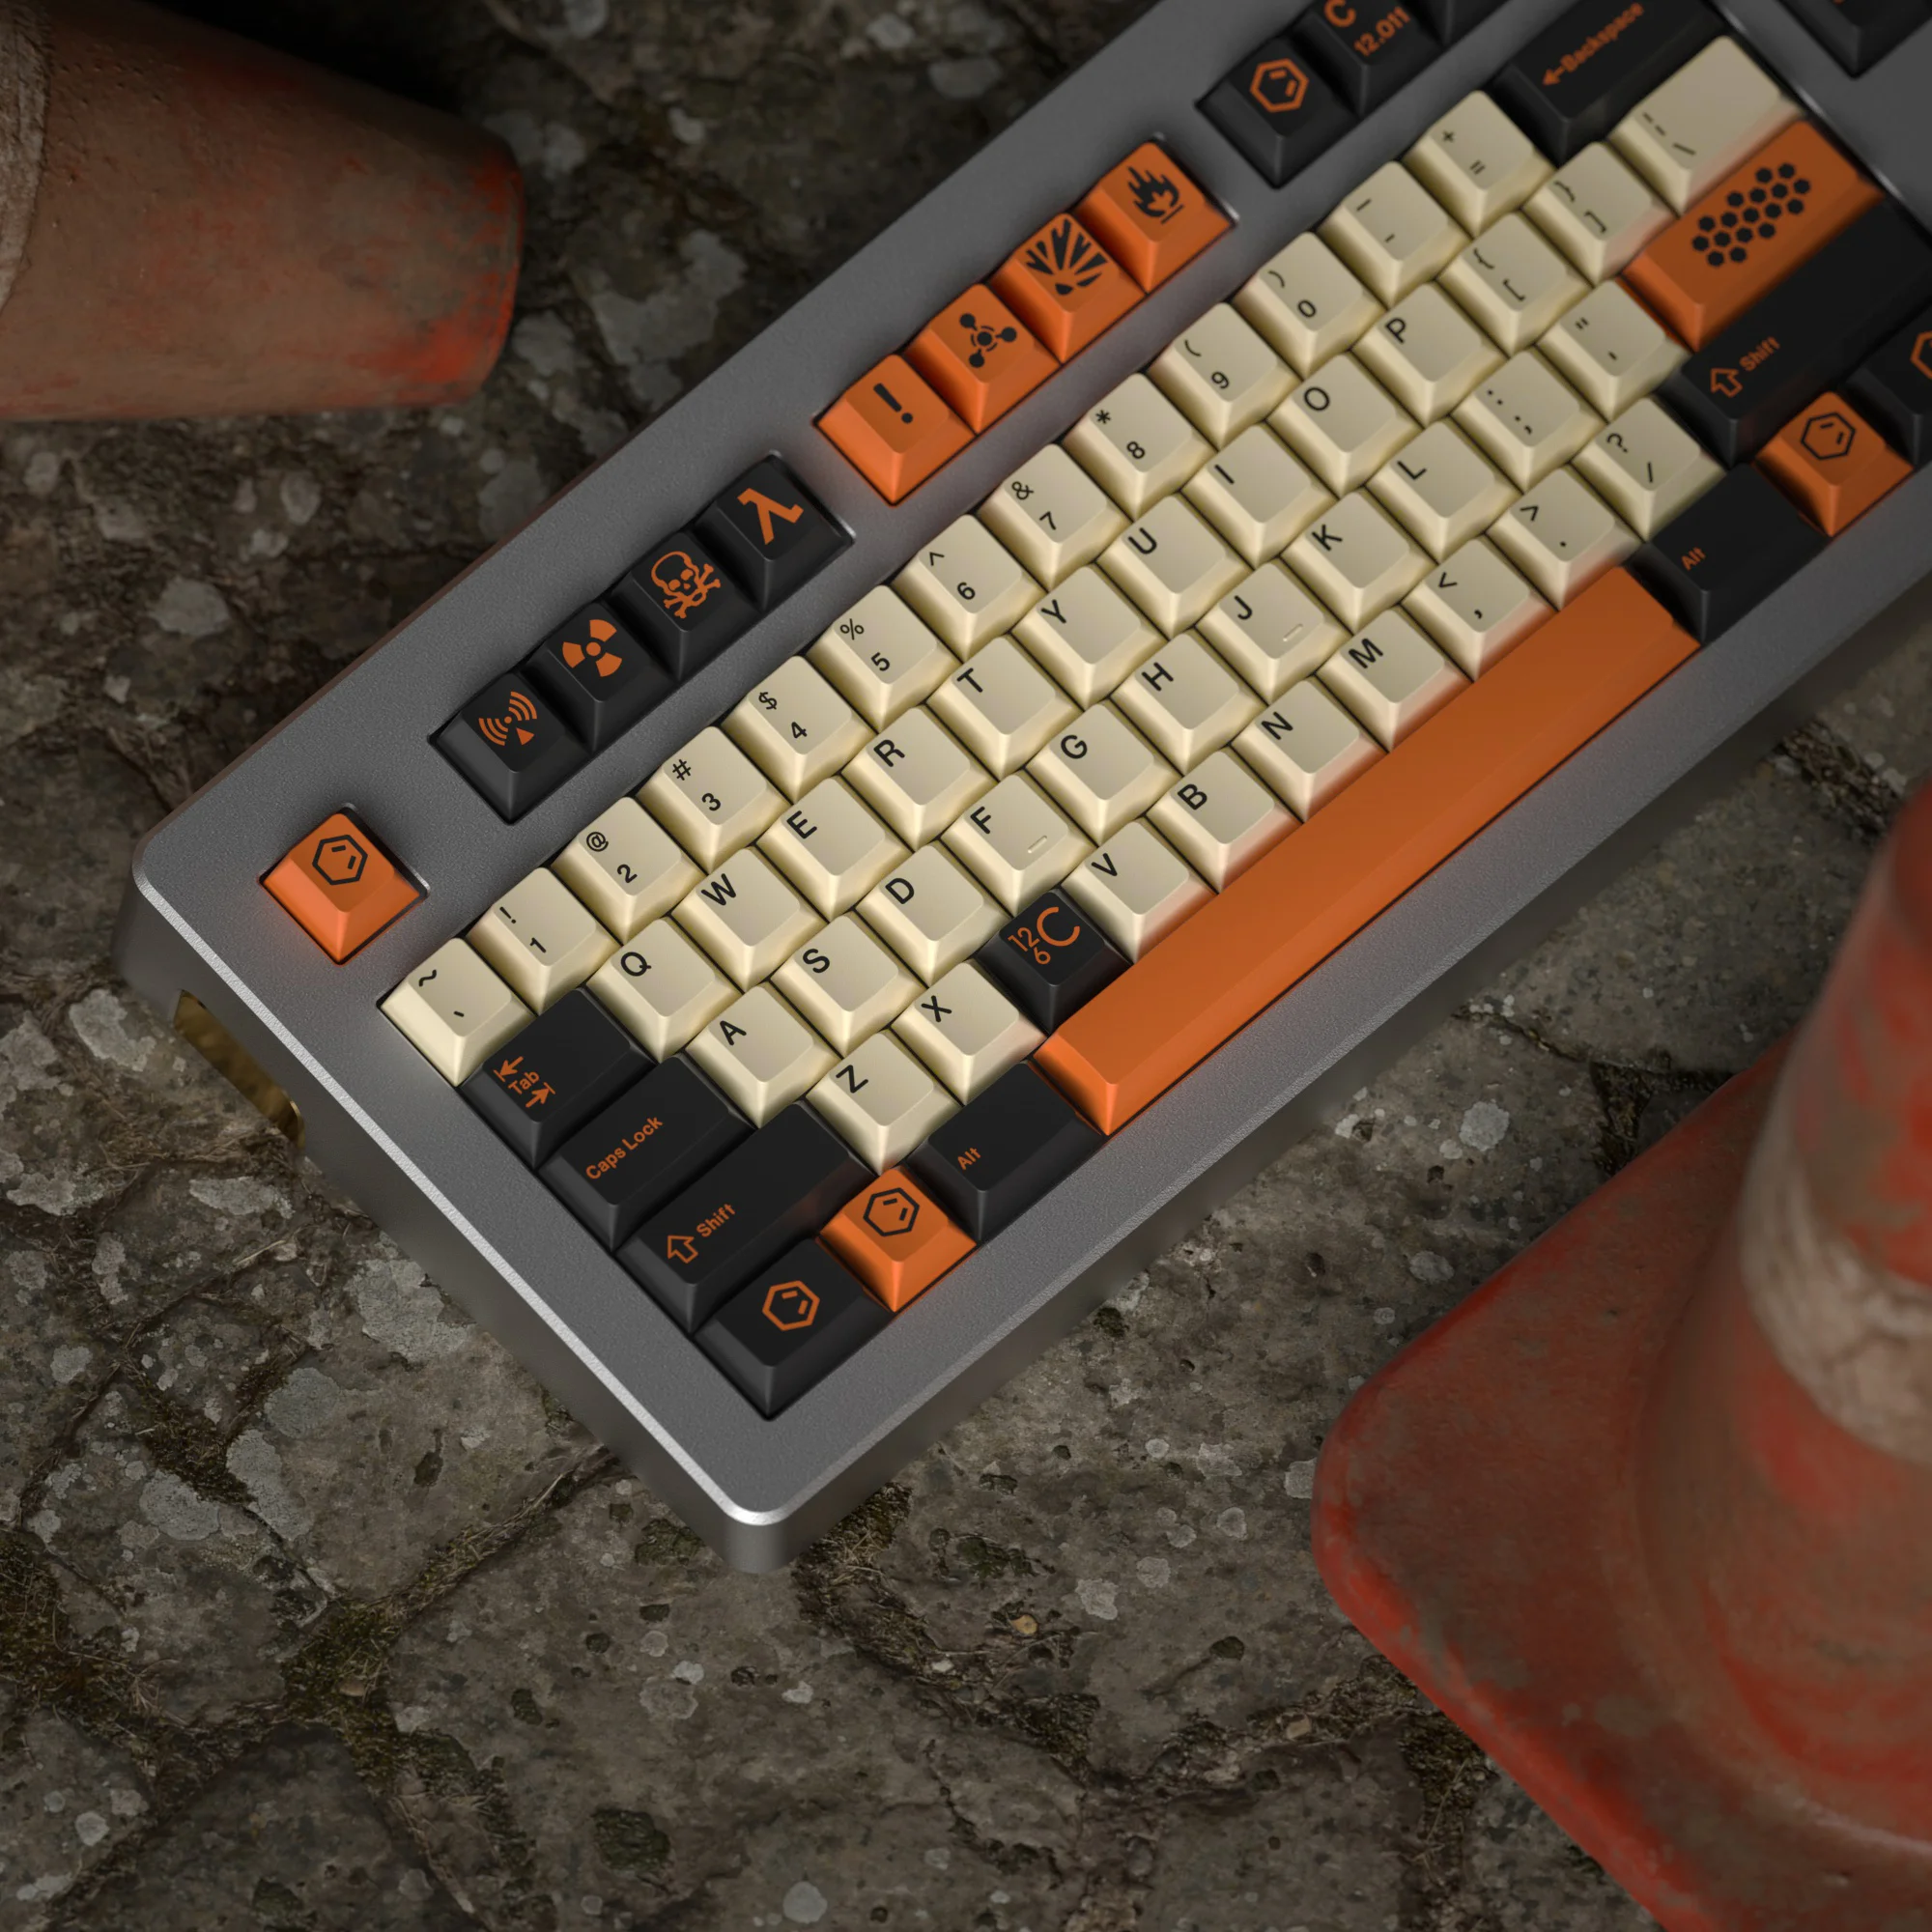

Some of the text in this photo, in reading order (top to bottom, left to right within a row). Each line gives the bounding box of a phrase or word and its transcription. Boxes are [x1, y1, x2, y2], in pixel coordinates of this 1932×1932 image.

[1353, 6, 1410, 56] 12.011
[1560, 2, 1644, 72] Backspace
[1584, 211, 1606, 234] ]
[1503, 279, 1525, 301] [
[1297, 299, 1317, 318] 0
[1385, 318, 1406, 344] P
[1740, 337, 1778, 371] Shift
[1211, 372, 1229, 389] 9
[1304, 387, 1330, 412] O
[1126, 441, 1145, 459] 8
[1606, 433, 1628, 453] ?
[1397, 461, 1427, 480] L
[1647, 462, 1654, 484] /
[1011, 481, 1034, 500] &
[1039, 511, 1056, 530] 7
[1128, 527, 1156, 554] U
[1312, 525, 1343, 552] K
[1682, 548, 1705, 570] Alt
[957, 582, 975, 600] 6
[1041, 600, 1066, 623] Y
[1235, 596, 1252, 620] J
[840, 618, 864, 639] %
[871, 652, 890, 671] 5
[1349, 639, 1383, 668] M
[957, 668, 982, 693] T
[1142, 663, 1173, 691] H
[758, 692, 777, 710] $
[791, 722, 807, 738] 4
[1262, 712, 1293, 740] N
[873, 740, 905, 767] R
[1061, 735, 1087, 759] G
[672, 759, 691, 781] #
[702, 793, 721, 810] 3
[1178, 784, 1208, 810] B
[786, 810, 817, 838] E
[970, 807, 991, 834] F
[586, 832, 609, 852] @
[617, 865, 638, 883] 2
[1092, 853, 1117, 876] V
[701, 873, 736, 905] W
[886, 878, 914, 904] D
[1037, 906, 1081, 947] C
[530, 938, 546, 952] 1
[621, 952, 651, 977] Q
[803, 949, 830, 973] S
[922, 996, 952, 1022] X
[721, 1021, 747, 1045] A
[507, 1071, 540, 1094] Tab
[835, 1065, 868, 1094] Z
[586, 1118, 663, 1179] Caps Lock
[958, 1148, 980, 1170] Alt
[696, 1205, 735, 1236] Shift
